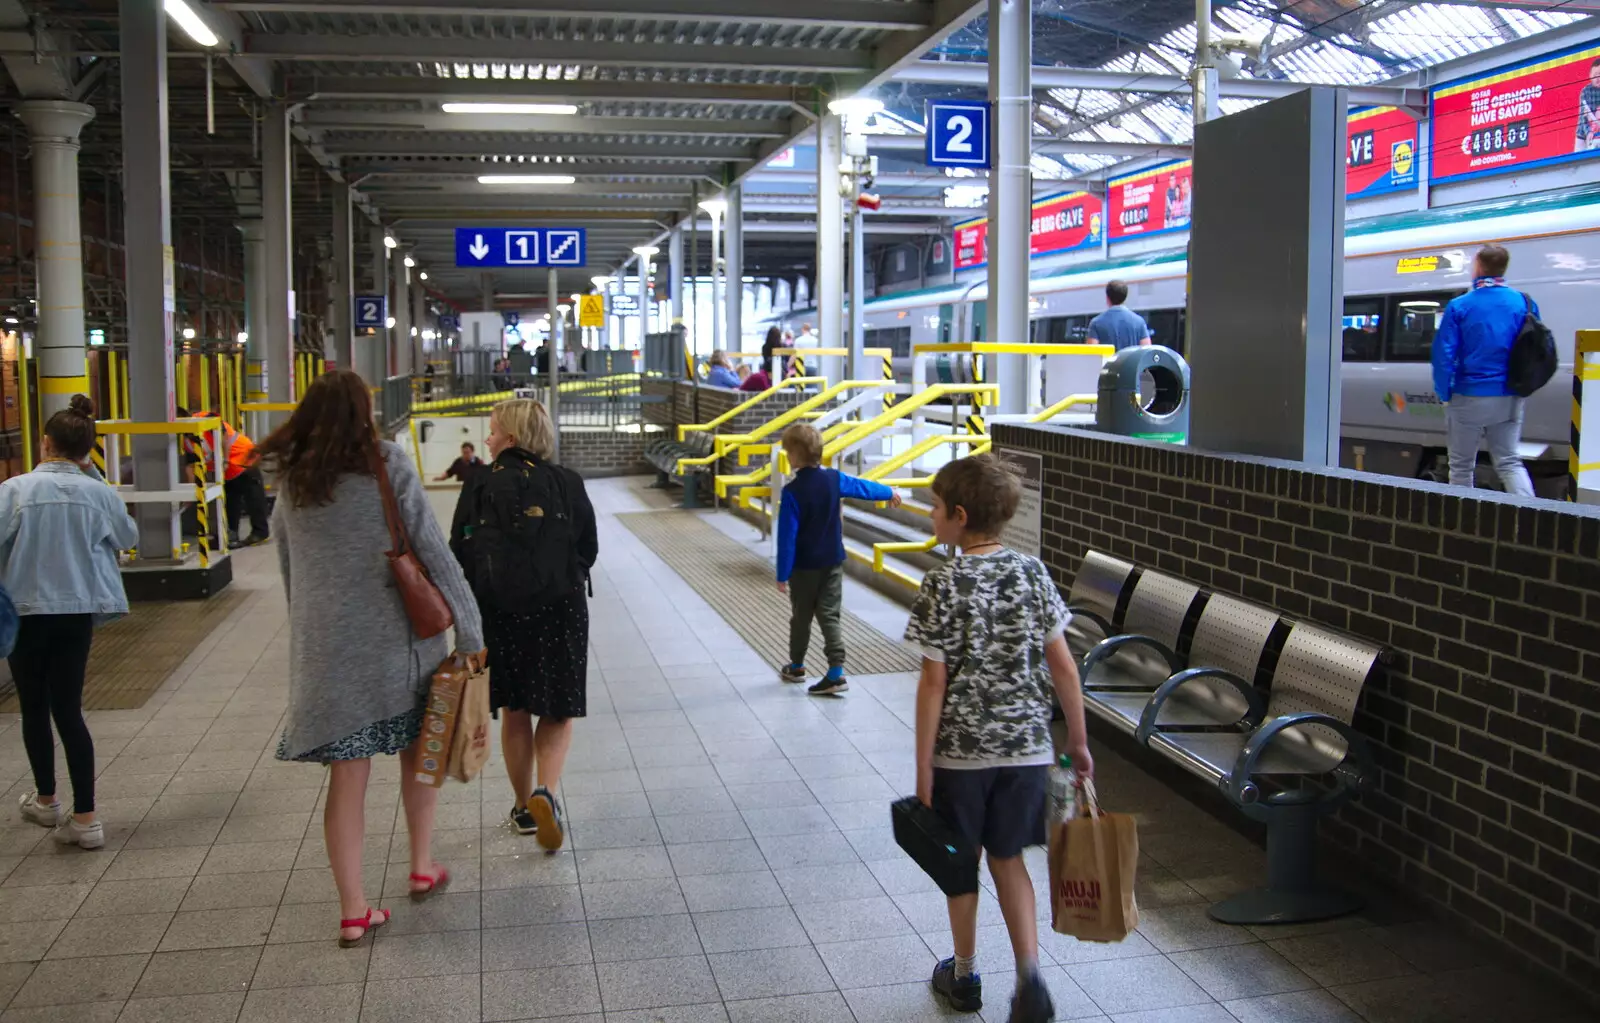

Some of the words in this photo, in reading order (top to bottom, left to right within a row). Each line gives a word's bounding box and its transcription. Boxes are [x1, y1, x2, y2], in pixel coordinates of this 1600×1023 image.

[1480, 89, 1491, 98] FAR
[1471, 98, 1490, 113] THE
[1471, 109, 1497, 127] HAVE
[1498, 101, 1533, 120] SAVED
[946, 115, 972, 152] 2
[516, 236, 528, 259] 1
[363, 302, 377, 321] 2
[1060, 880, 1102, 900] MUJI
